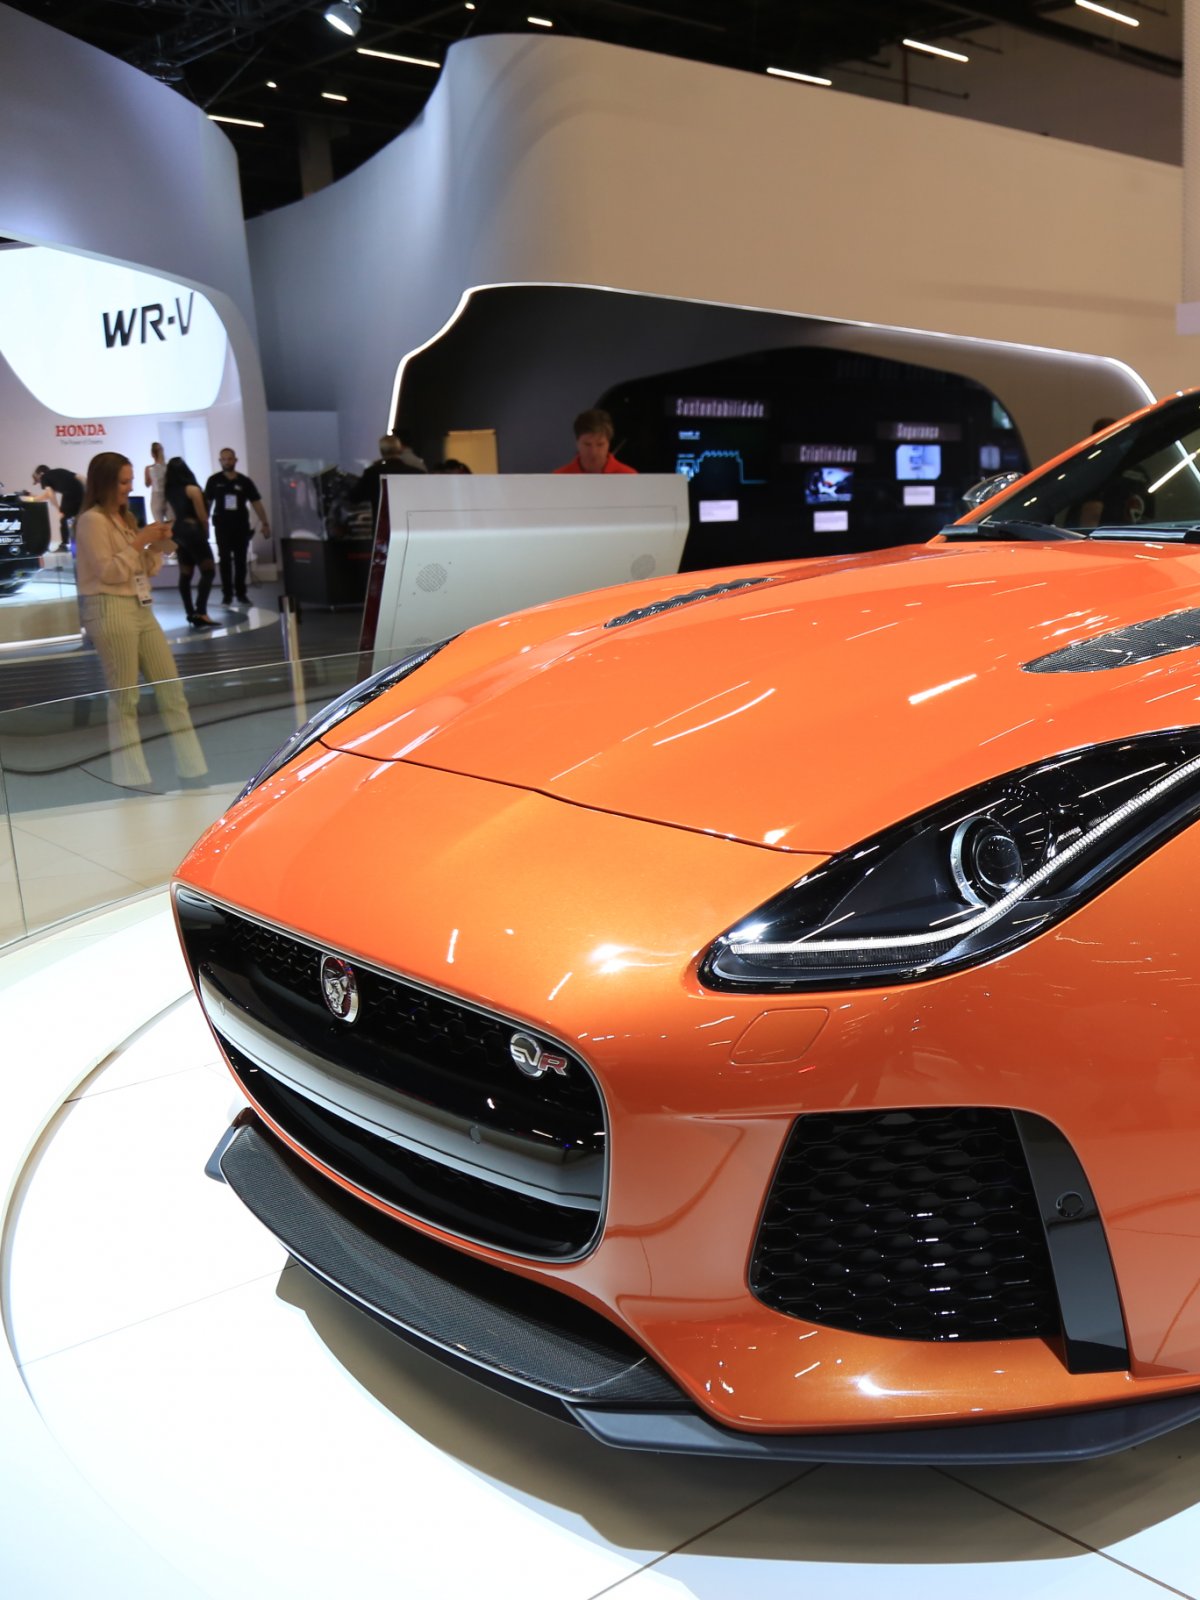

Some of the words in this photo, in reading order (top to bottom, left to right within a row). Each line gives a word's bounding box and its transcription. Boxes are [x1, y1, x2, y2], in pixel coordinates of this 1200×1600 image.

[102, 292, 194, 348] WR-V
[676, 398, 764, 418] Sustentabilidade
[55, 424, 106, 437] HONDA
